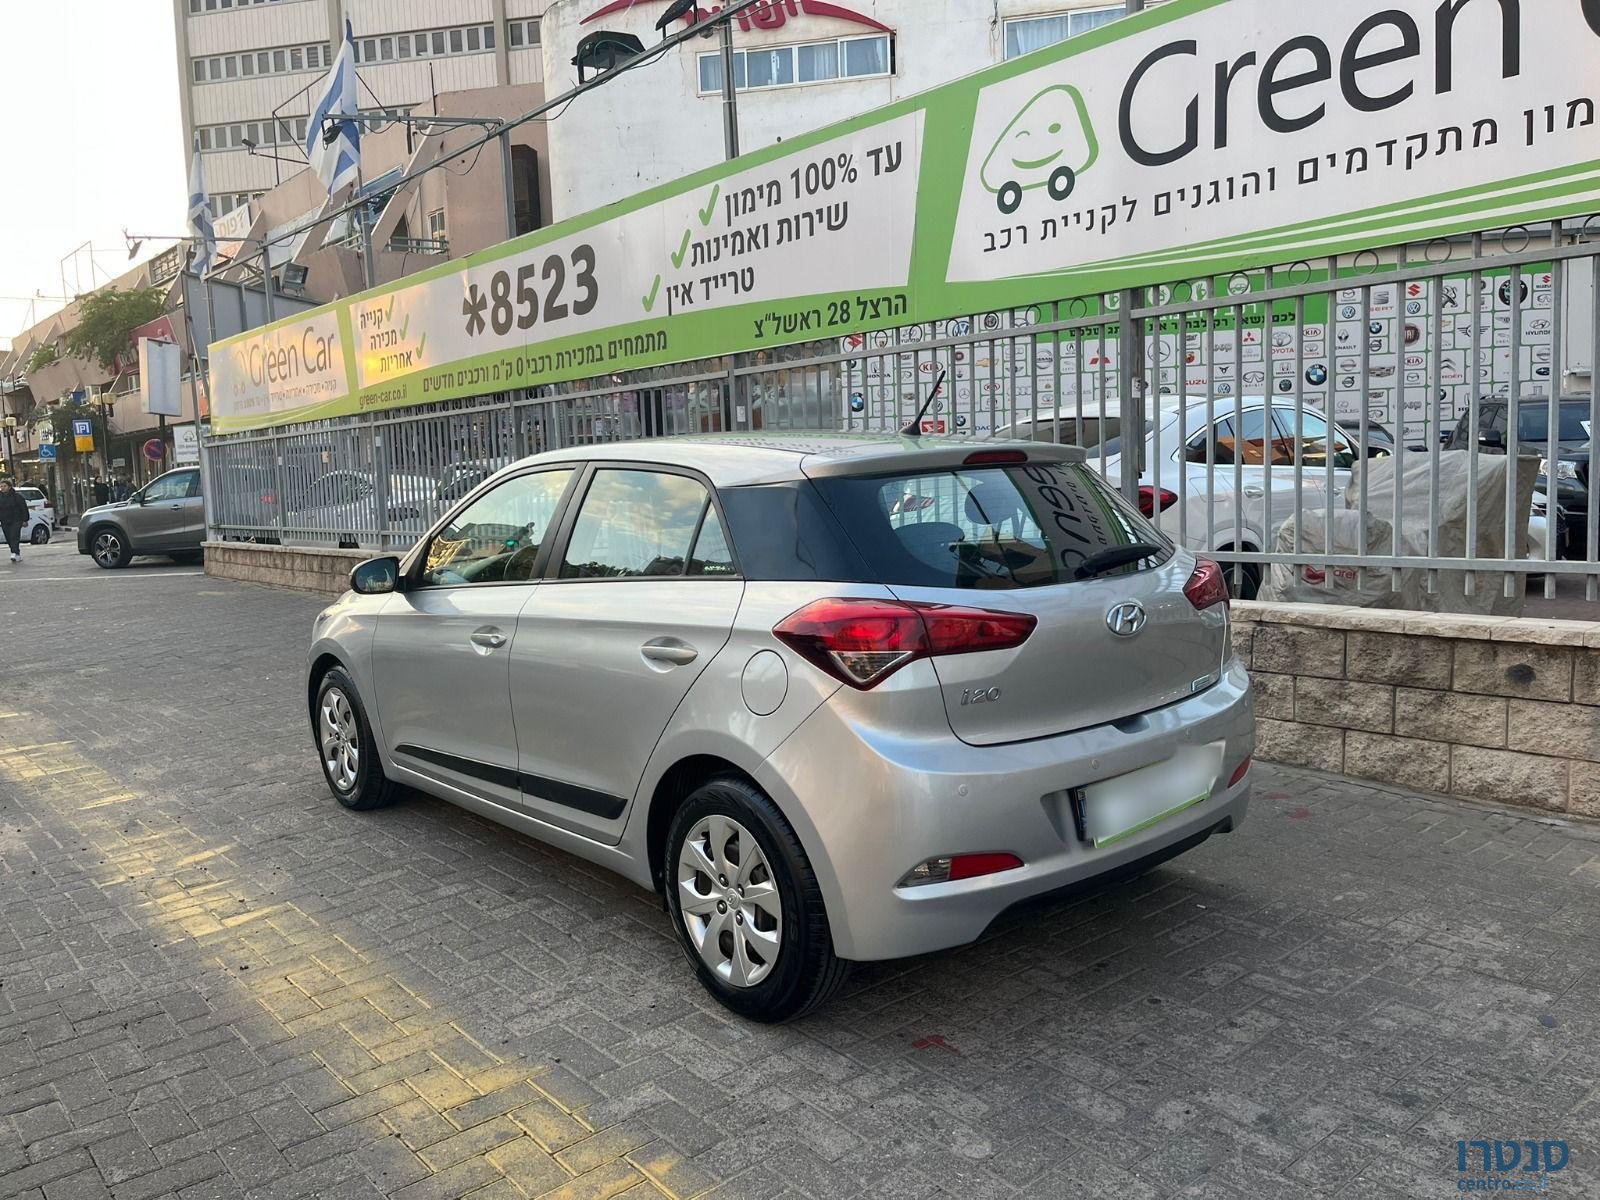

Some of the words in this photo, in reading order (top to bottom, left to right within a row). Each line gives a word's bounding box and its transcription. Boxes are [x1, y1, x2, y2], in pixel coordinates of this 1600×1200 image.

[1118, 0, 1520, 167] Green
[1523, 97, 1594, 146] מון
[866, 141, 903, 177] עד
[1299, 118, 1499, 186] מתקדמים
[790, 153, 858, 200] 100%
[725, 179, 782, 227] מימון
[1153, 166, 1277, 217] והוגנים
[776, 200, 848, 245] שירות
[1040, 195, 1138, 242] לקניית
[690, 222, 769, 267] ואמינות
[983, 223, 1028, 253] רכב
[666, 280, 694, 316] אין
[699, 266, 755, 301] טרייד
[360, 307, 384, 331] קנייה
[827, 299, 850, 327] 28
[856, 293, 907, 321] הרצל
[1271, 312, 1296, 323] לכם
[370, 330, 398, 351] מכירה
[607, 330, 668, 360] מתמחים
[1271, 347, 1295, 355] OYOTA
[250, 342, 298, 388] Green
[302, 326, 335, 375] Car
[380, 349, 413, 374] אחריות
[516, 356, 524, 377] 0
[525, 356, 552, 375] רכבי
[556, 344, 605, 371] במכירת
[422, 375, 454, 393] חדשים
[457, 367, 489, 387] ורכבים
[493, 359, 513, 385] ק"מ
[359, 383, 408, 409] green-car.co.il
[960, 686, 1001, 706] i20
